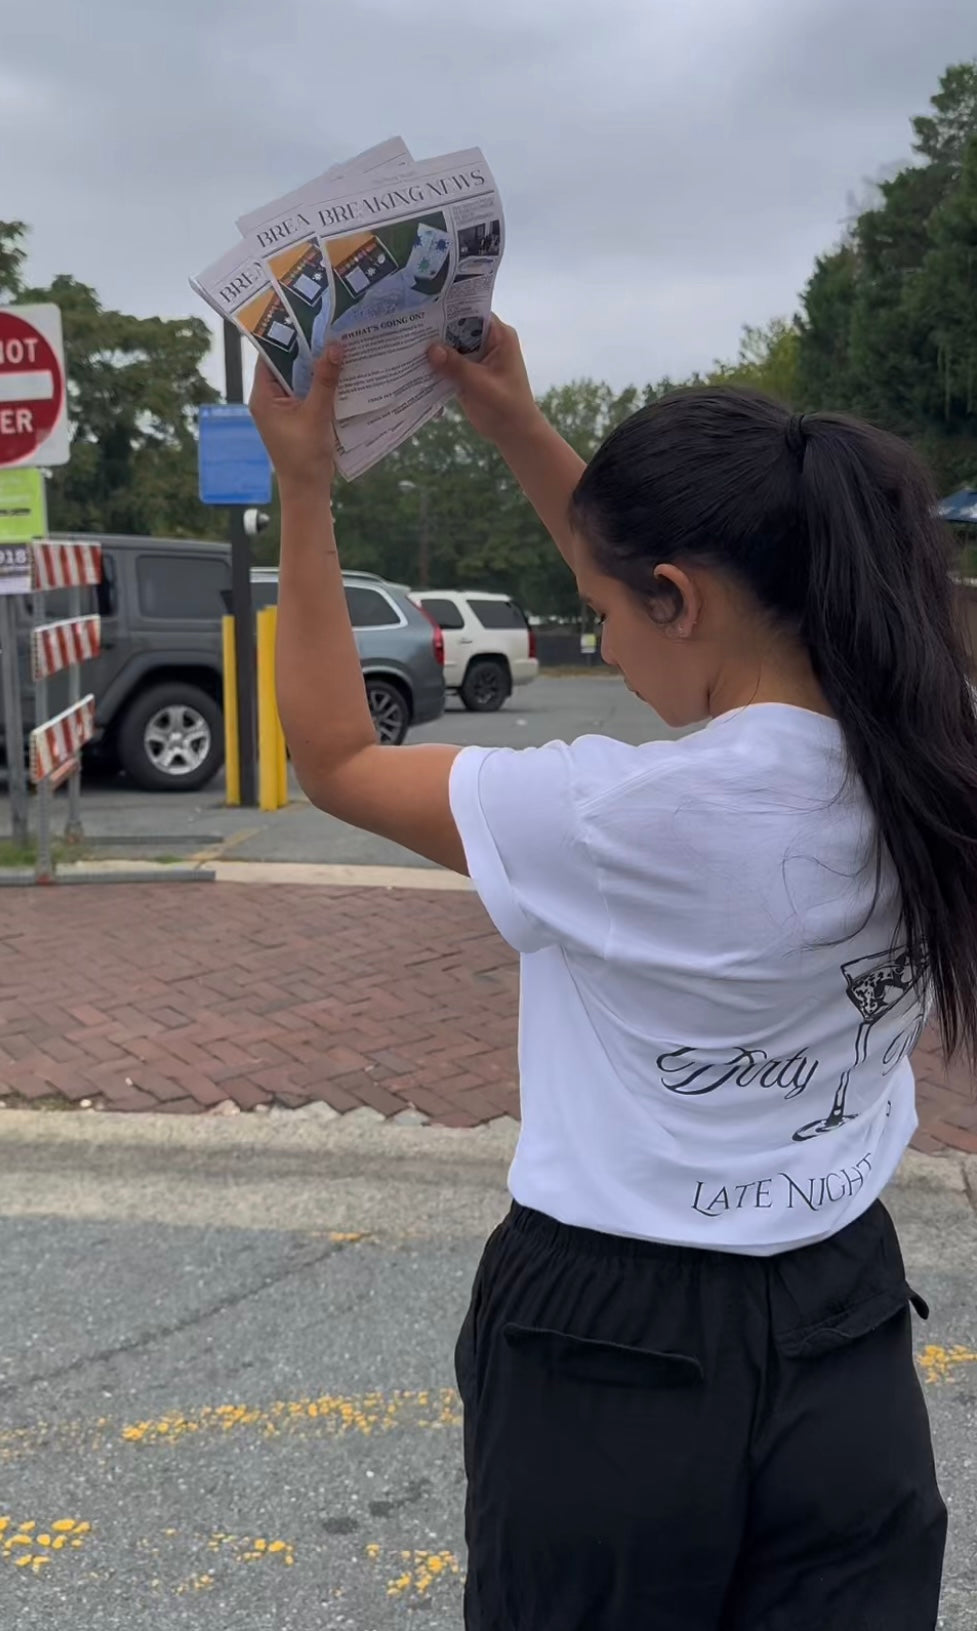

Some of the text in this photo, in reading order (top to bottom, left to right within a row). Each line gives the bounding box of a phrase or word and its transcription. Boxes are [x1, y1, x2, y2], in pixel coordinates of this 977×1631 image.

[318, 185, 424, 227] BREAKING
[425, 168, 486, 198] NEWS
[0, 407, 33, 434] ER
[691, 1152, 872, 1218] LATE NIGHT
